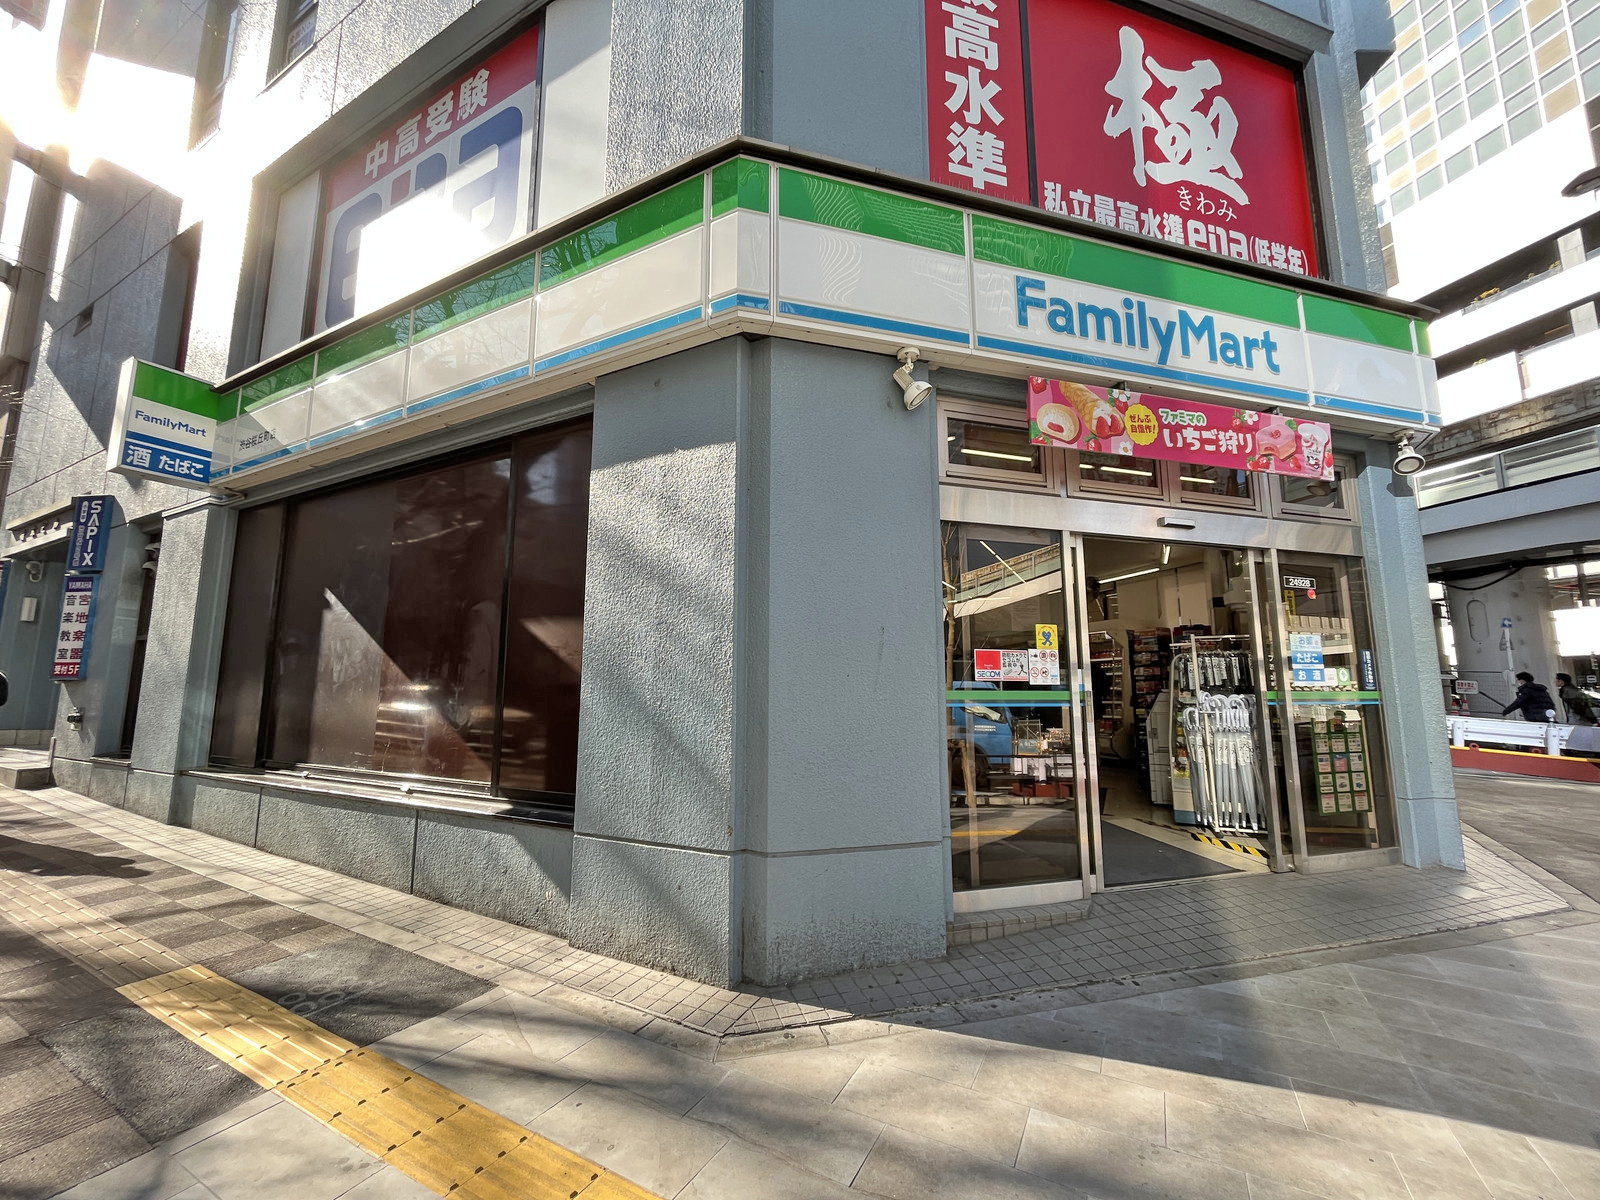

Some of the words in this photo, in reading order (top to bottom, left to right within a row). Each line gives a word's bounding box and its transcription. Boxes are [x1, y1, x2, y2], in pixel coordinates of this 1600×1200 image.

[942, 0, 1008, 190] 高水準
[364, 68, 490, 179] 中高受験
[1103, 25, 1250, 205] 極
[1176, 185, 1238, 223] きわみ
[1015, 275, 1281, 375] FamilyMart
[134, 409, 207, 438] FamilyMart
[1129, 413, 1152, 423] ぜんぶ
[1160, 409, 1206, 425] ファミマの
[1162, 427, 1253, 454] いちご狩り
[126, 444, 152, 468] 酒
[158, 454, 204, 478] たばこ
[82, 500, 102, 566] SAPIX
[56, 594, 77, 660] 音楽教室
[69, 594, 91, 660] 宮地楽器
[53, 664, 80, 675] 受付5F
[976, 670, 1001, 678] SECOM
[1296, 652, 1319, 663] たばこ
